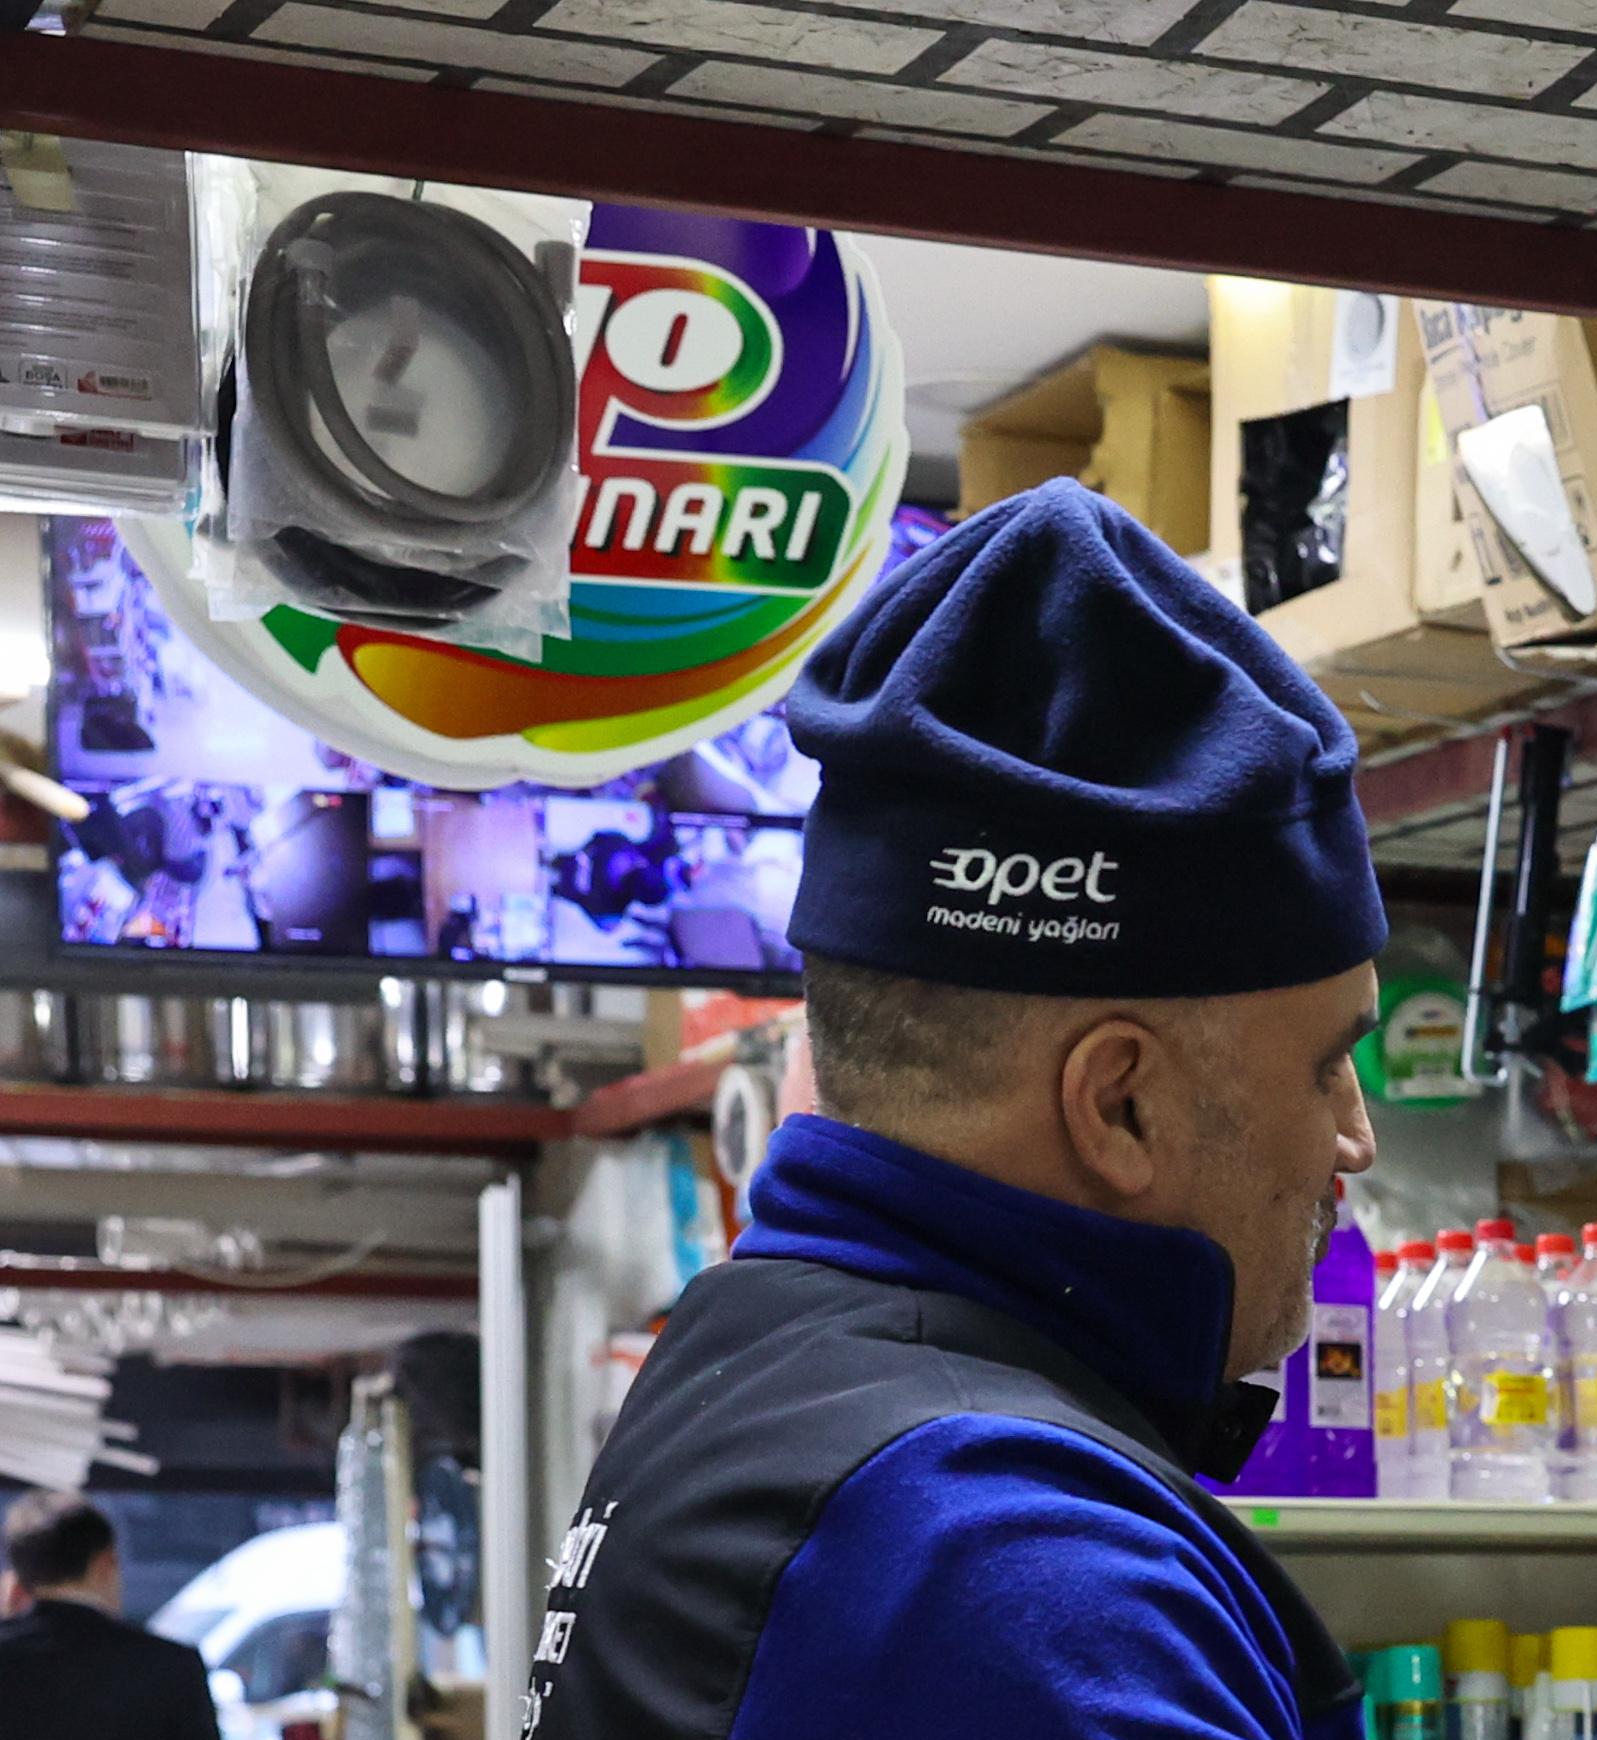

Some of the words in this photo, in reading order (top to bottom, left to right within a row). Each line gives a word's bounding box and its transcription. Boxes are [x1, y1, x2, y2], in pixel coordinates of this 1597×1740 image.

[929, 848, 1119, 905] opet
[927, 905, 1023, 936] madeni
[1028, 915, 1120, 944] yağları
